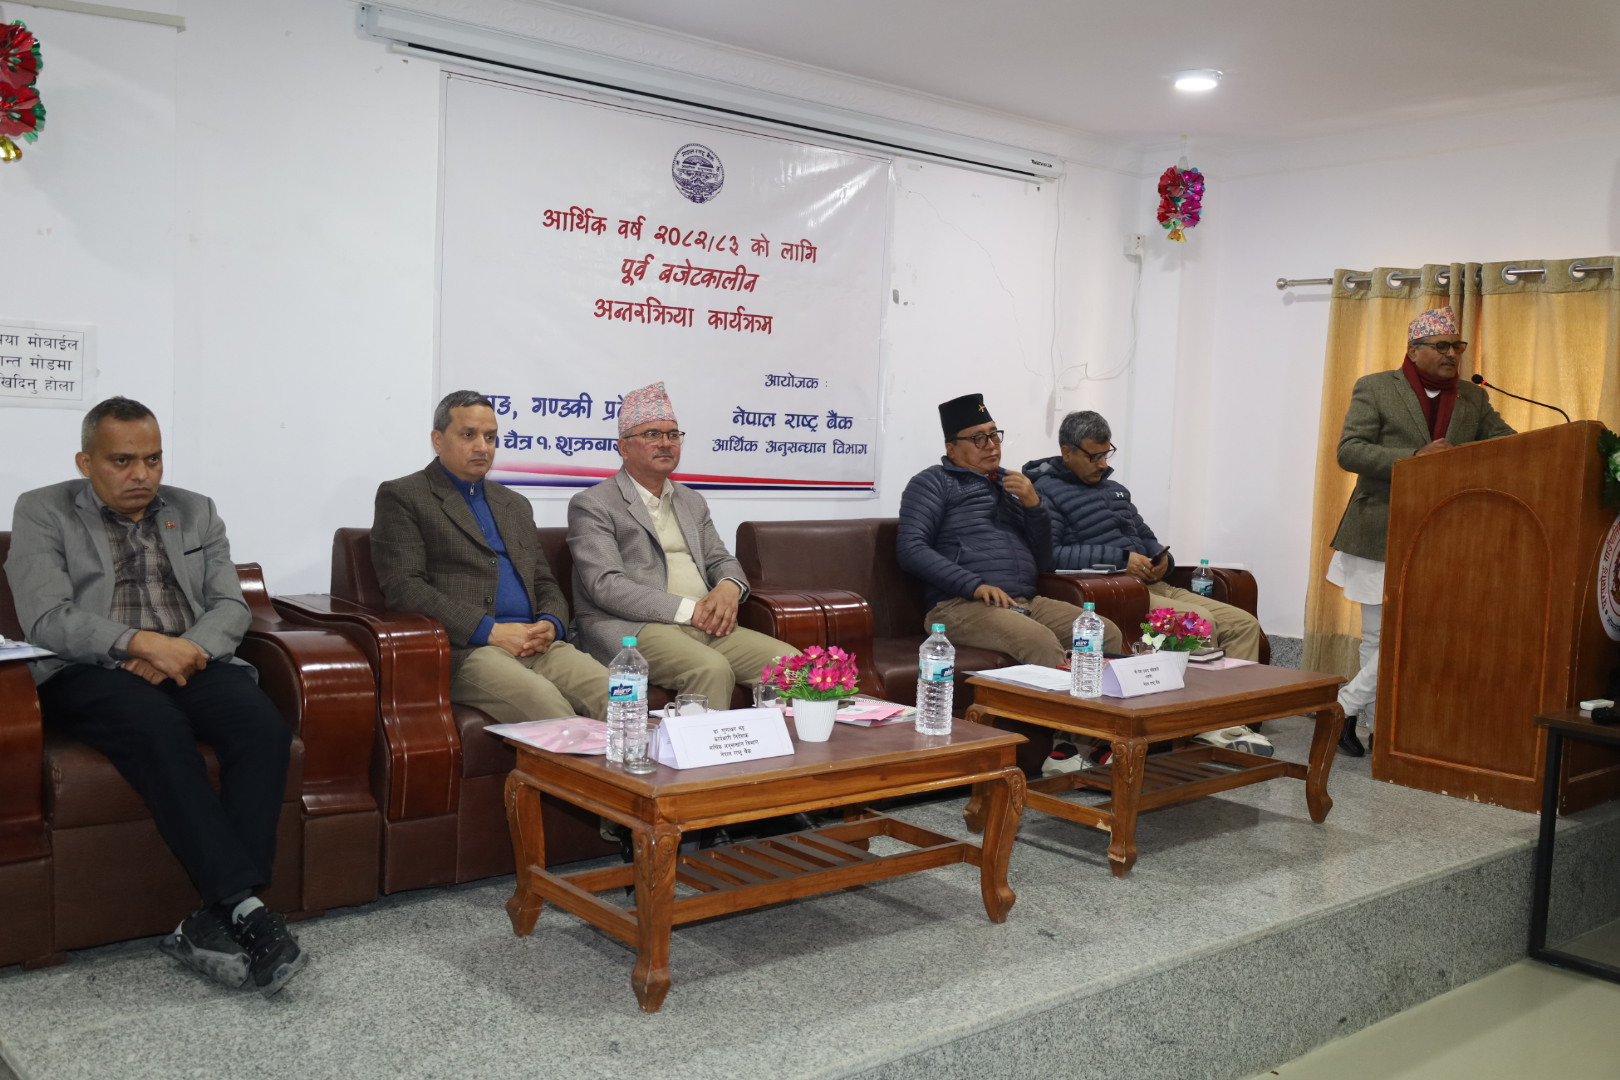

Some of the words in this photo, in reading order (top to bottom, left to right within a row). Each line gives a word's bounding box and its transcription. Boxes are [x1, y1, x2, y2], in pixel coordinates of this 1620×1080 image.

[542, 205, 608, 236] आर्थिक
[617, 215, 646, 241] वर्ष
[750, 233, 770, 258] को
[780, 238, 818, 264] लागि
[621, 253, 655, 286] पूर्व
[658, 258, 760, 293] बजेटकालीन
[707, 305, 774, 335] कार्यक्रम
[27, 333, 79, 351] मोबाईल
[29, 354, 73, 371] मोडमा
[44, 376, 76, 392] होला
[764, 372, 820, 389] आयोजक
[531, 392, 593, 419] गण्डकी
[732, 405, 776, 428] नेपाल
[784, 413, 819, 432] राष्ट्र
[504, 429, 534, 450] चैत्र
[711, 435, 759, 452] आर्थिक
[765, 440, 827, 456] अनुसन्धान
[832, 438, 868, 455] विभाग
